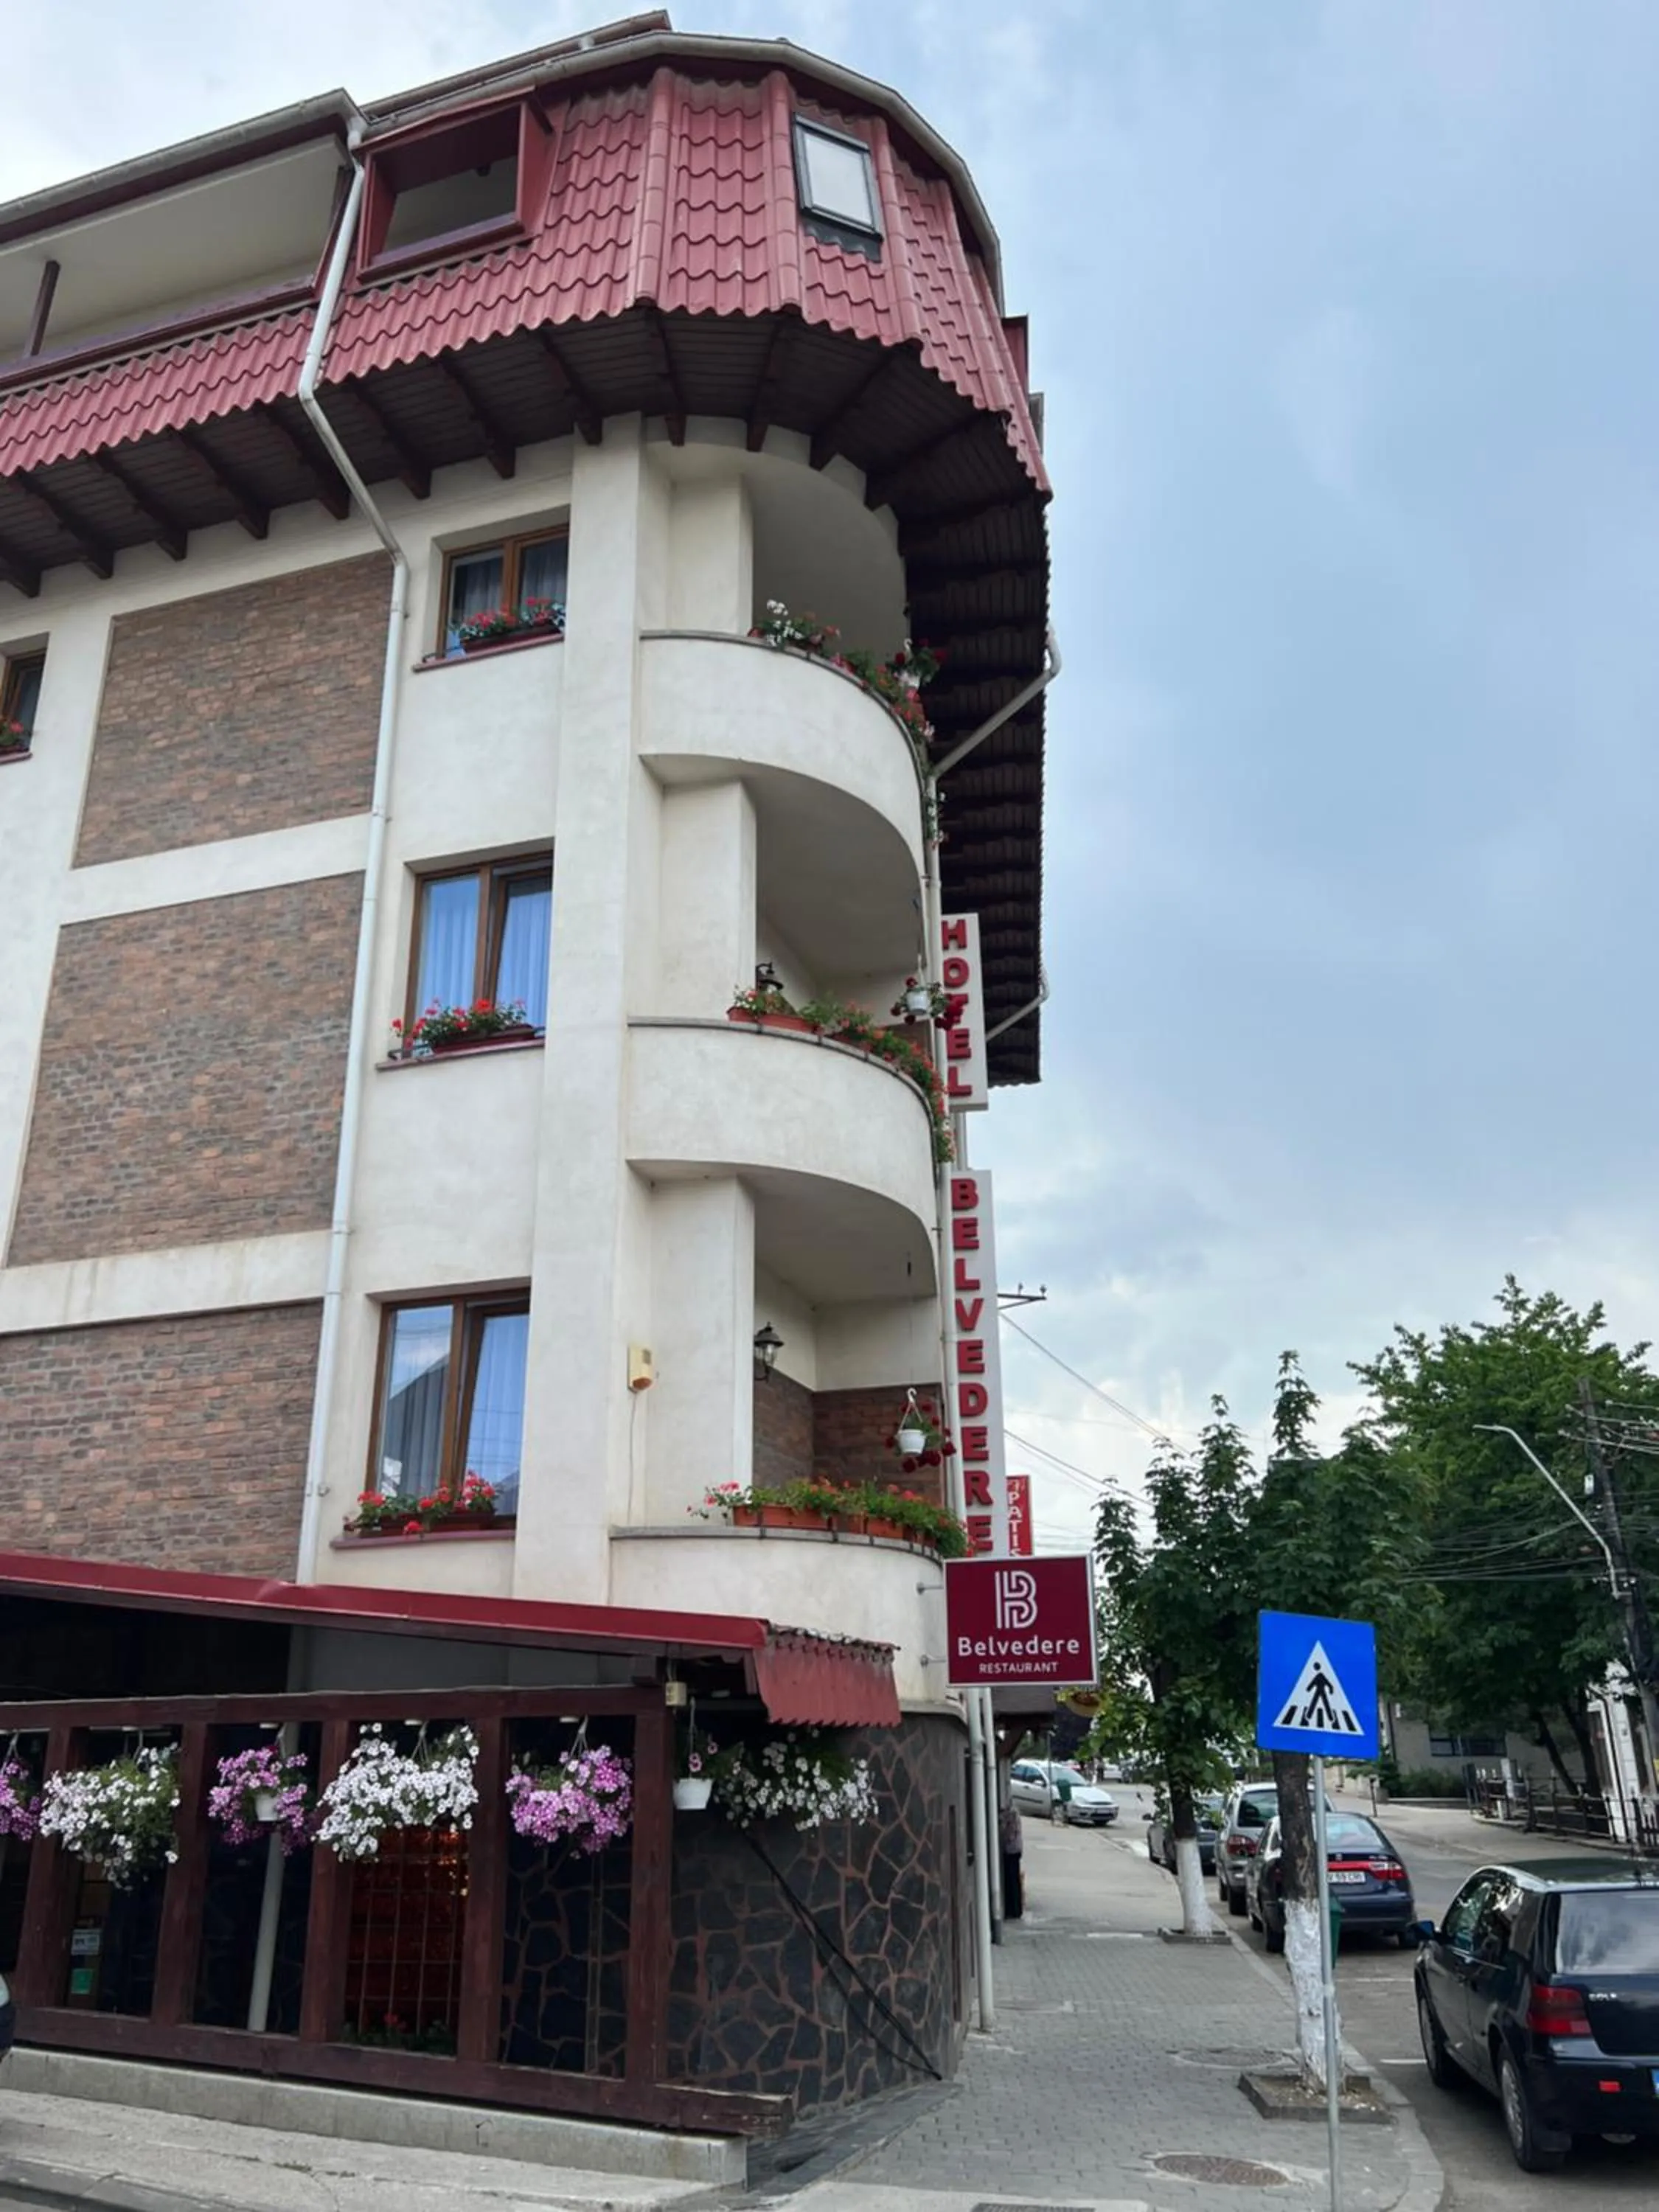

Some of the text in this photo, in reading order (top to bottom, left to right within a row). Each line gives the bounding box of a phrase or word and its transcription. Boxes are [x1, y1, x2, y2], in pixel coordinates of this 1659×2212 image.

[942, 919, 972, 1097] HOTEL
[950, 1178, 993, 1553] BELVEDERE
[958, 1635, 1080, 1657] Belvedere
[978, 1662, 1059, 1674] RESTAURANT
